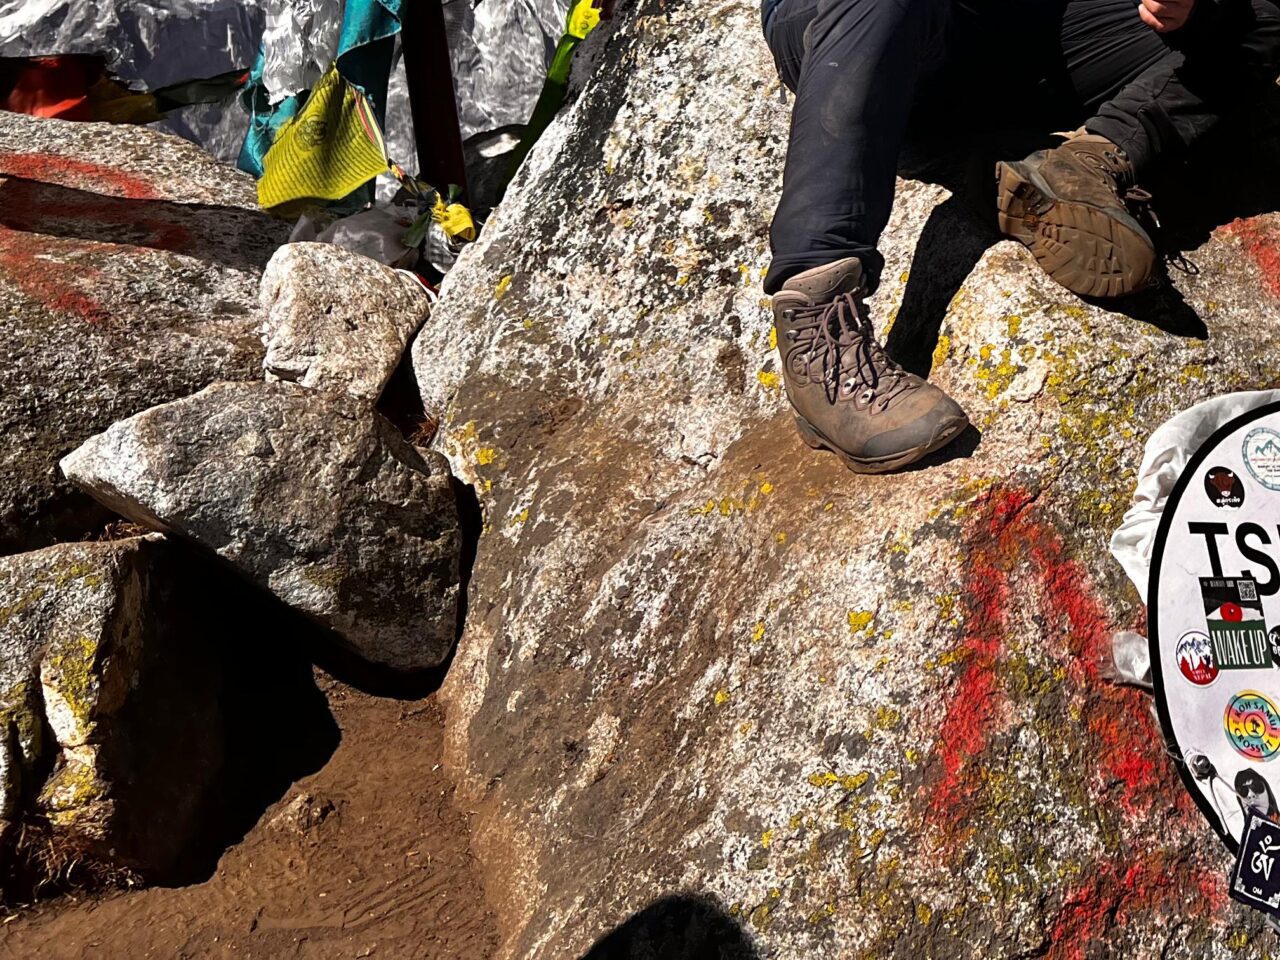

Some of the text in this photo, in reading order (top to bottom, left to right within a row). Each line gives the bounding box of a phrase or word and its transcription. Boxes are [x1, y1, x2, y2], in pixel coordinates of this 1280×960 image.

[1211, 629, 1268, 666] WAKE UP
[1234, 701, 1252, 719] KOH
[1253, 701, 1278, 731] SAMUI
[1233, 728, 1274, 753] CROSSFIT
